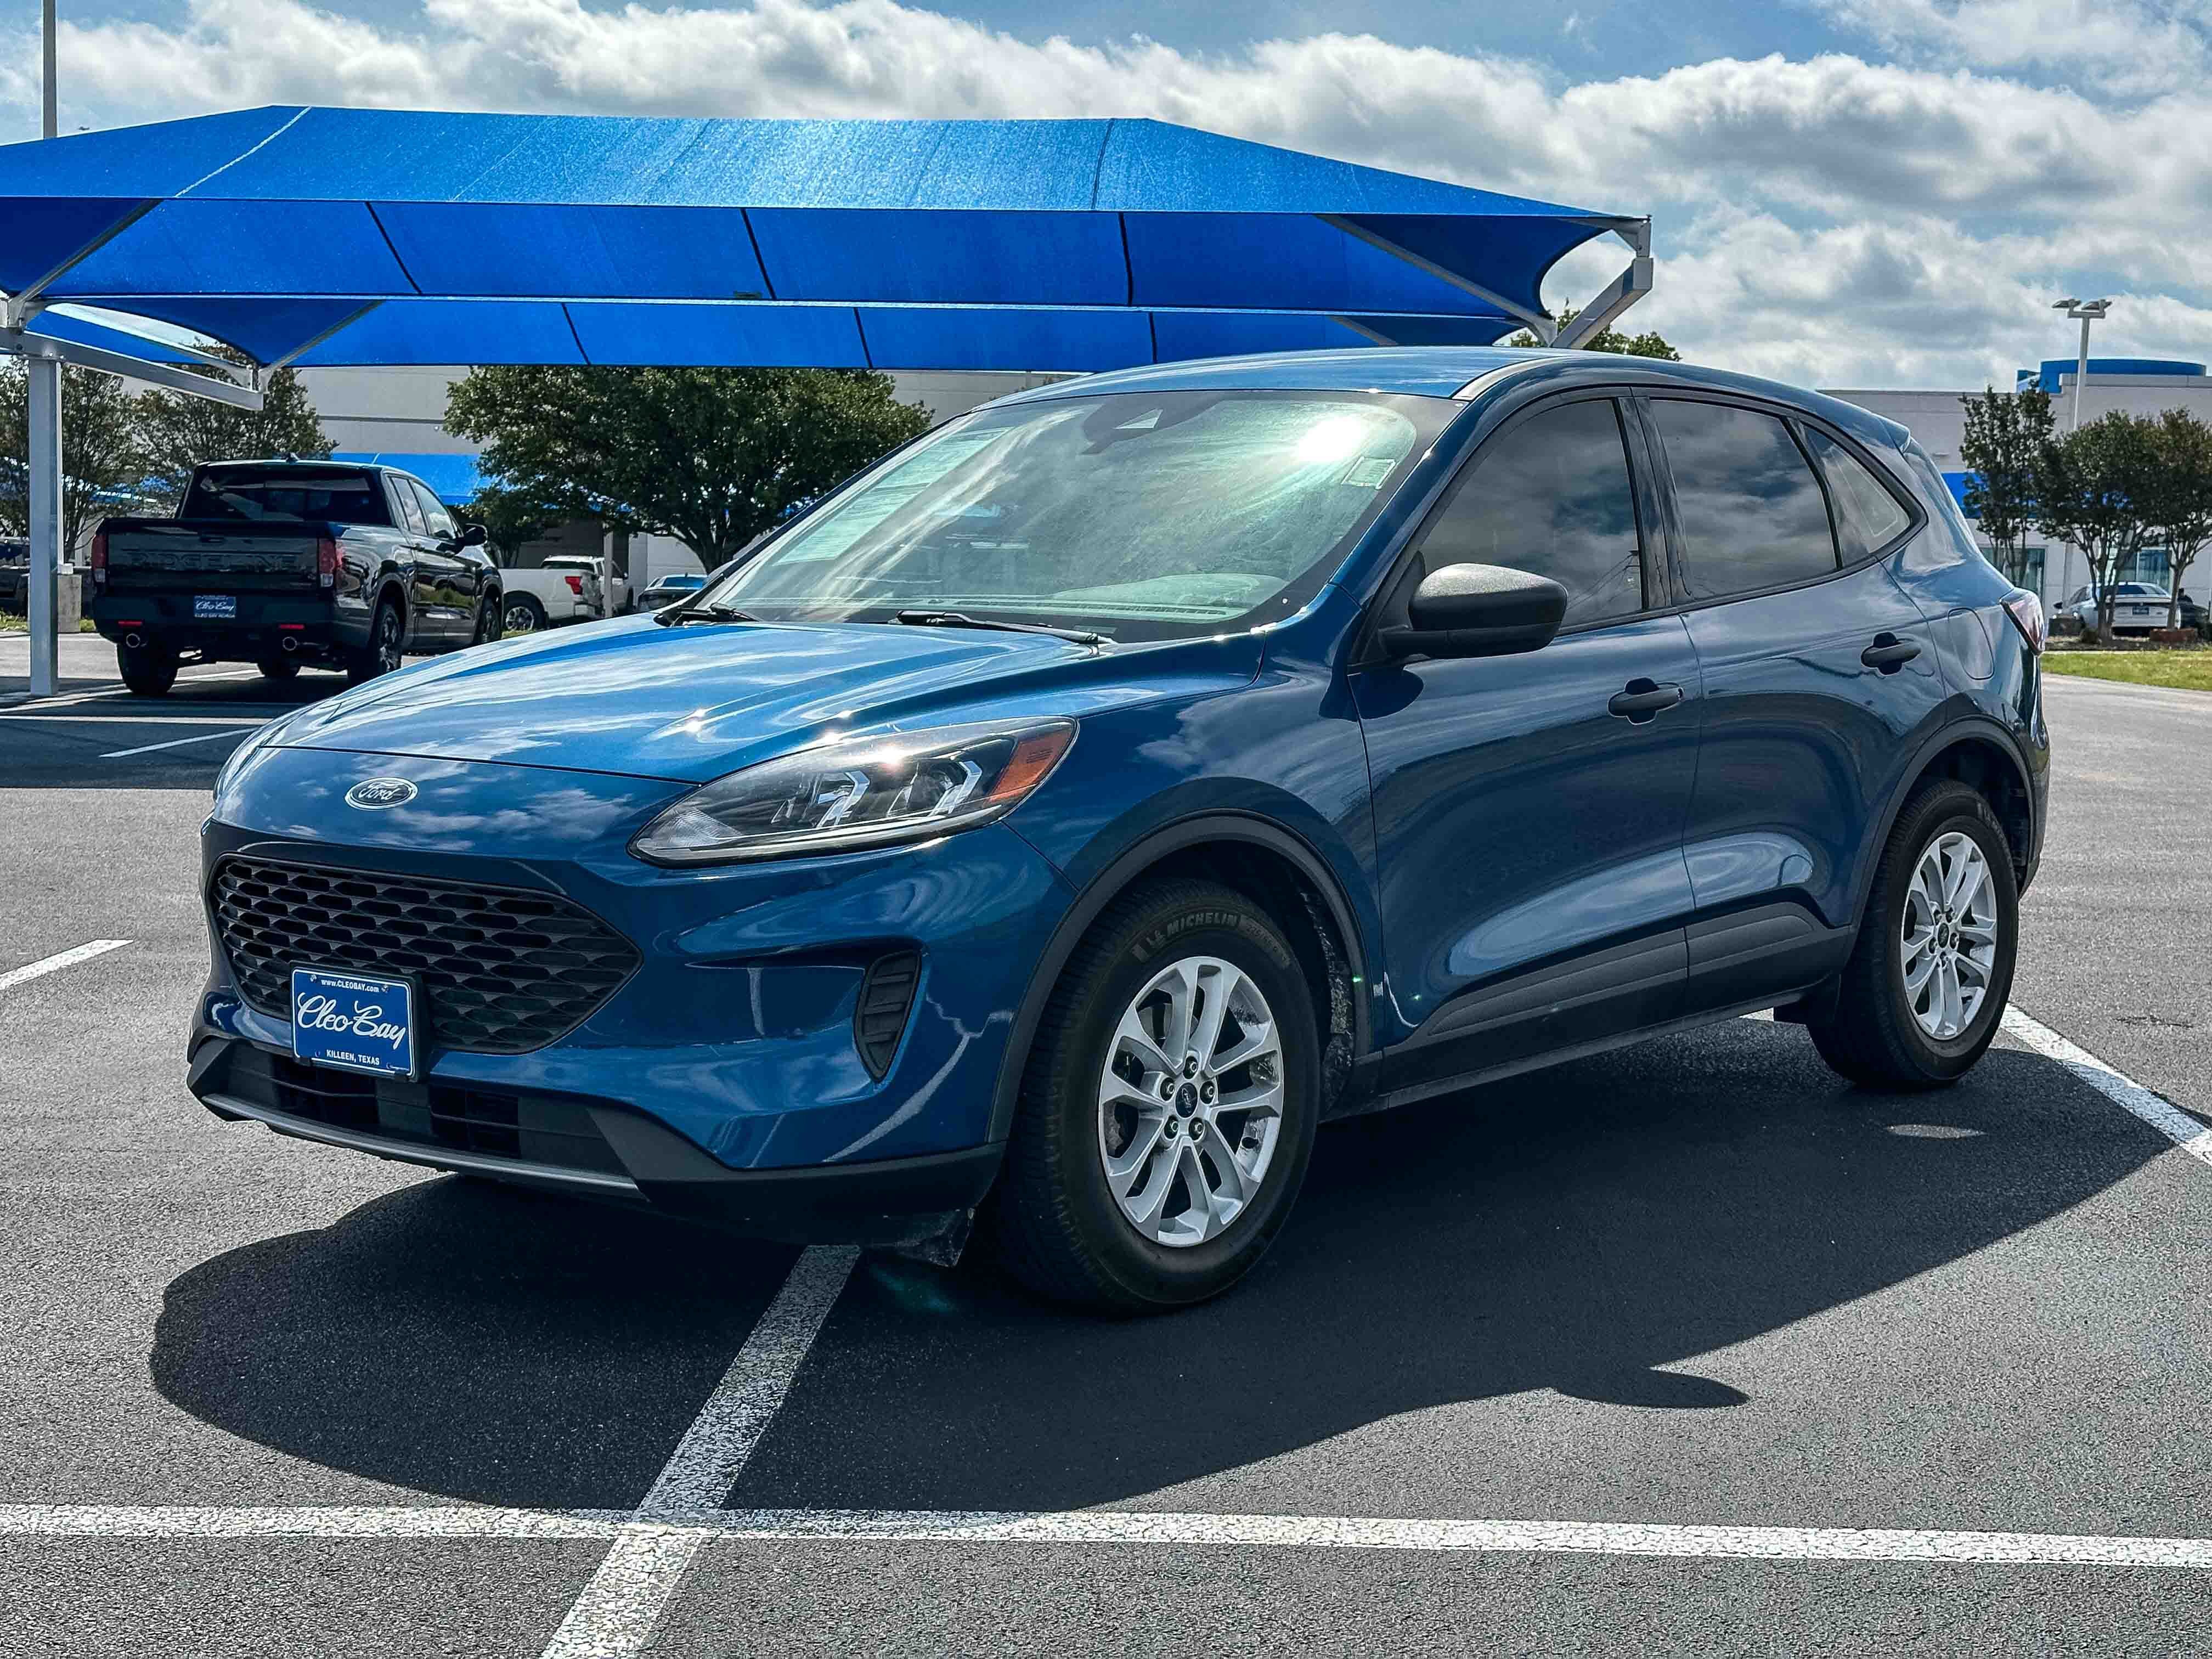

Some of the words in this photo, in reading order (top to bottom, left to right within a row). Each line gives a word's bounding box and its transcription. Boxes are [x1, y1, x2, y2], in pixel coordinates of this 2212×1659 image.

[358, 781, 403, 800] Ford
[1167, 912, 1238, 936] MICHELIN
[321, 980, 379, 992] www.CLEOBAY.com
[297, 992, 352, 1031] Cleo
[353, 1000, 406, 1050] Bay
[326, 1049, 356, 1063] KILLEEN,
[358, 1054, 380, 1065] TEXAS
